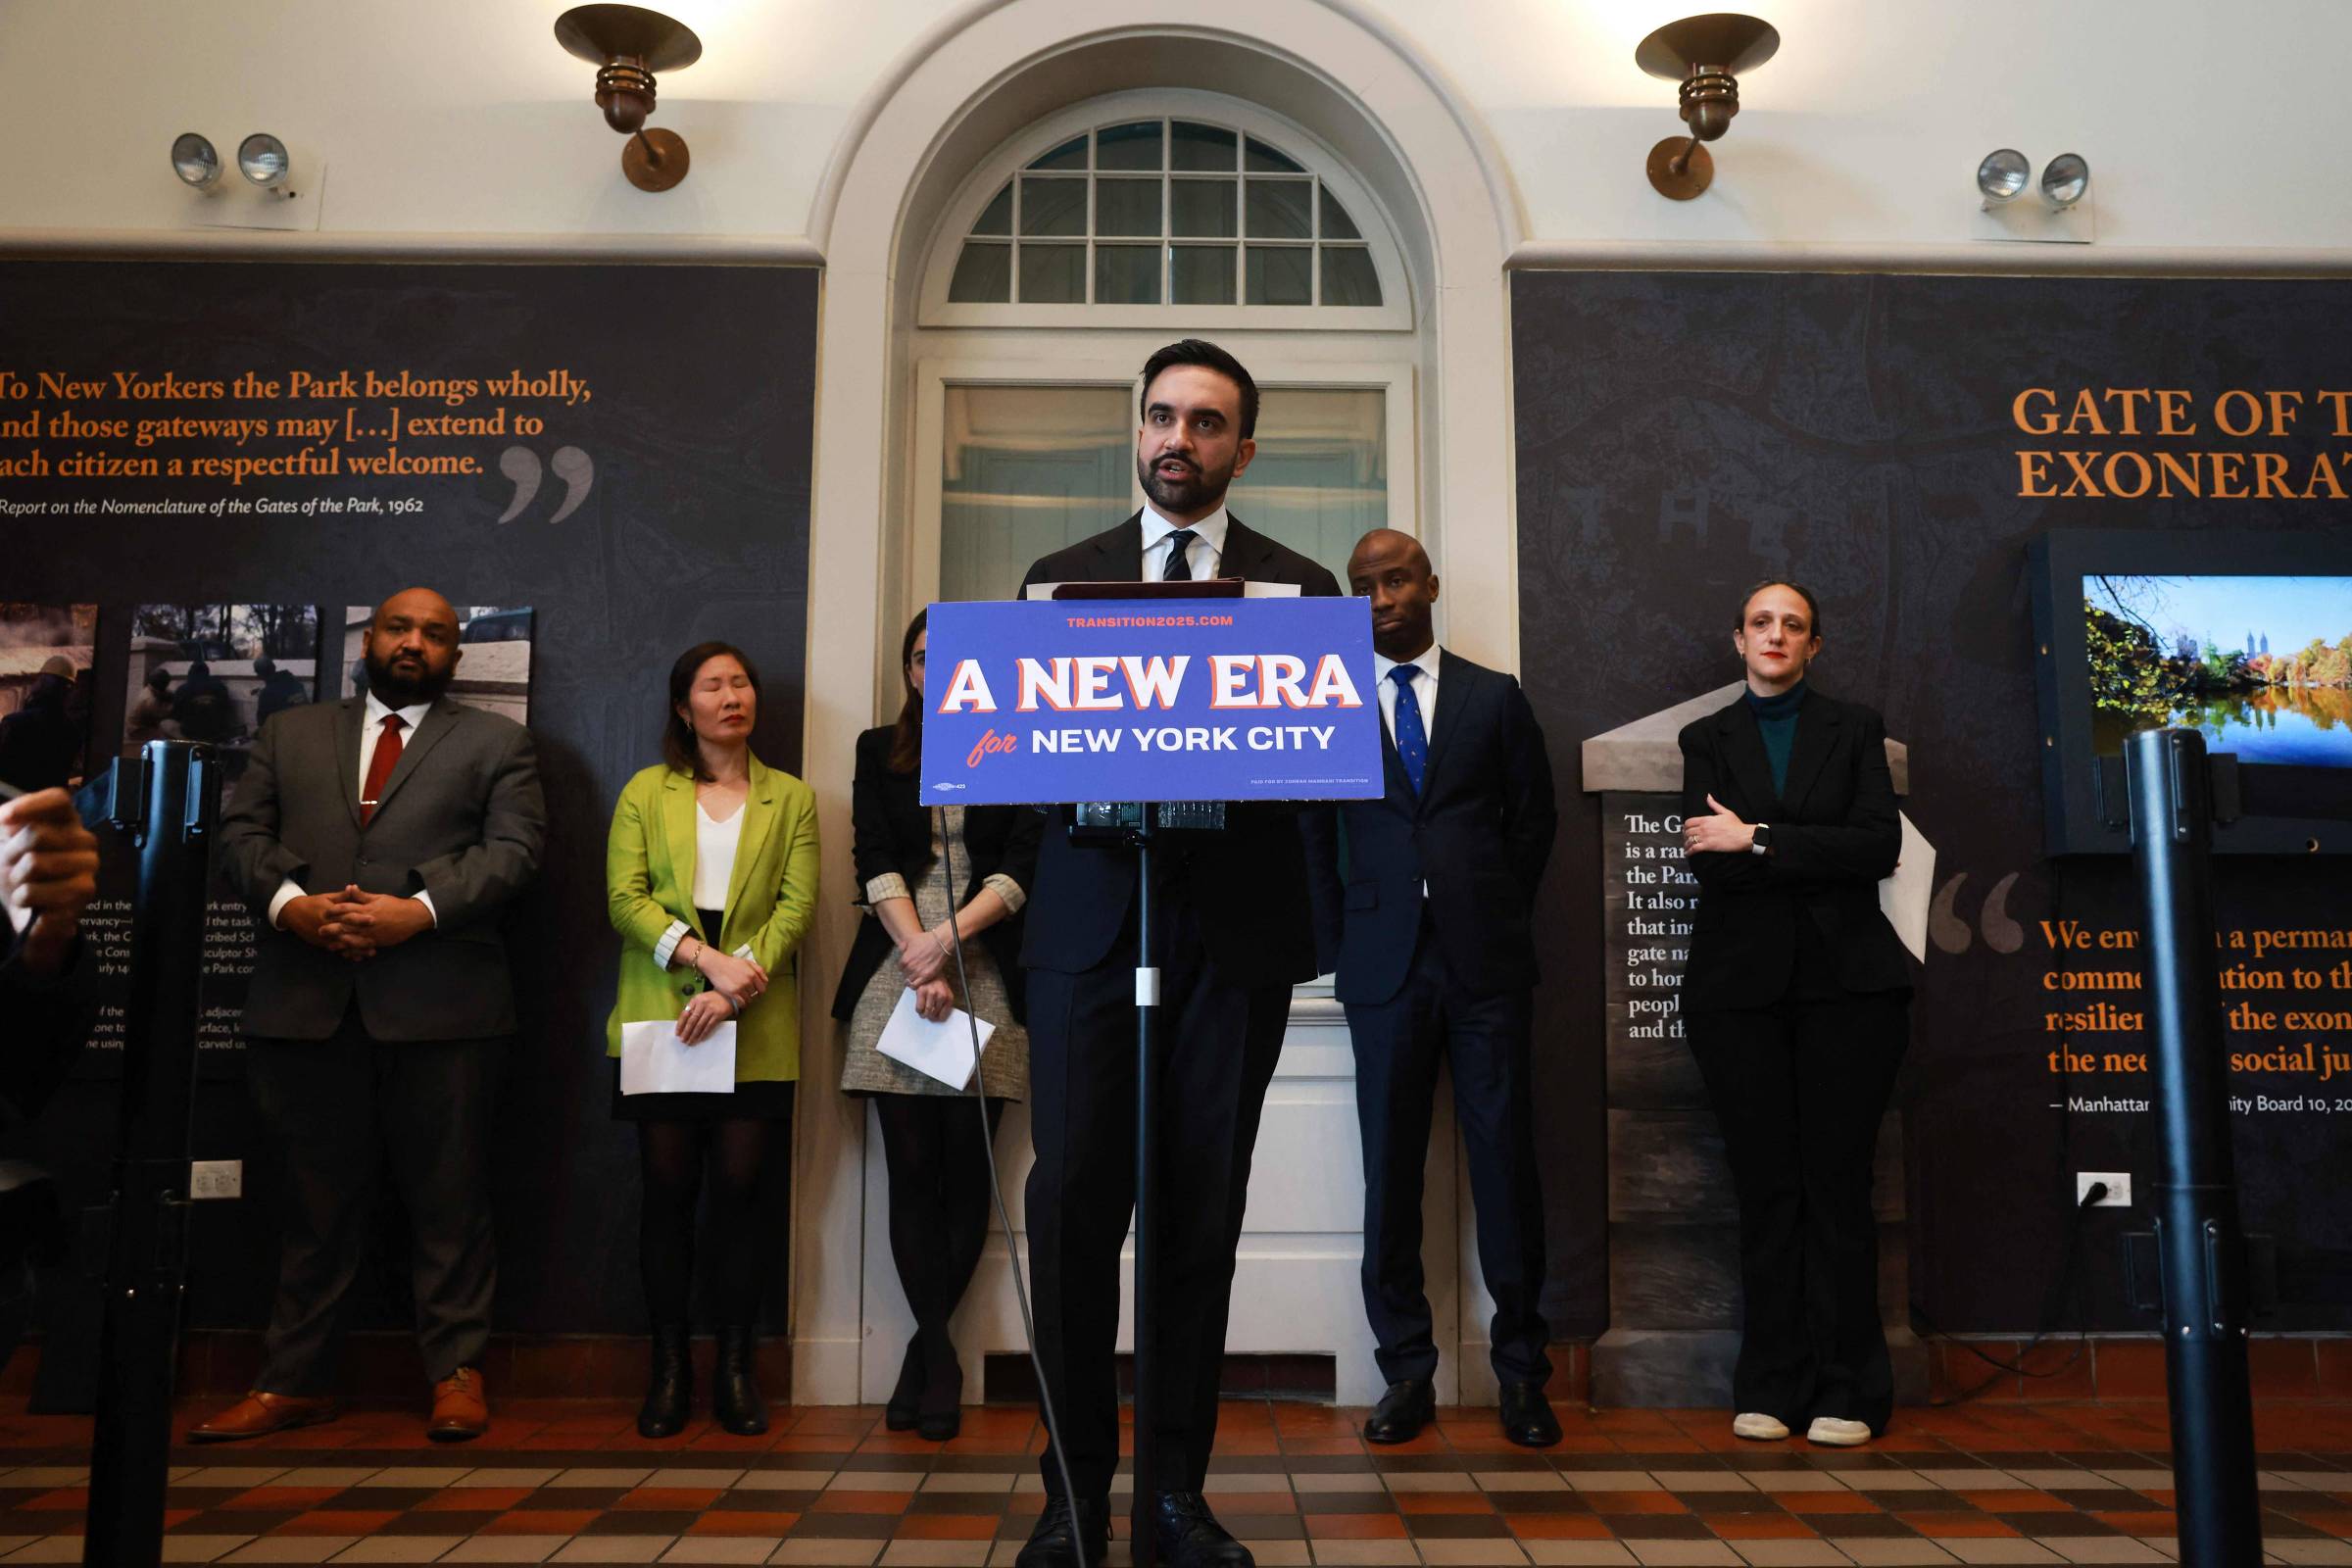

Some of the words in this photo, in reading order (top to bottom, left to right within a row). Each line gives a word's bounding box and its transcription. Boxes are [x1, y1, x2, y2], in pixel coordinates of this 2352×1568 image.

[0, 370, 29, 400] To
[36, 370, 108, 400] New
[113, 369, 224, 400] Yorkers
[233, 369, 280, 399] the
[289, 369, 359, 399] Park
[365, 368, 479, 406] belongs
[485, 368, 592, 405] wholly,
[2012, 387, 2198, 436] GATE
[2214, 389, 2304, 437] OF
[49, 409, 129, 438] those
[135, 416, 269, 447] gateways
[275, 416, 339, 444] may
[407, 407, 506, 436] extend
[513, 413, 544, 436] to
[58, 450, 159, 477] citizen
[167, 458, 184, 476] a
[191, 447, 340, 484] respectful
[347, 445, 483, 475] welcome.
[2015, 450, 2352, 499] EXONERA
[0, 498, 47, 517] Report
[50, 501, 70, 514] on
[74, 498, 97, 514] the
[101, 498, 206, 514] Nomenclature
[209, 498, 226, 517] of
[227, 498, 252, 514] the
[255, 498, 298, 514] Gates
[300, 497, 318, 517] of
[319, 497, 344, 514] the
[347, 498, 384, 515] Park,
[388, 501, 424, 514] 1962
[1066, 614, 1233, 629] TRANSITION2025.COM
[937, 658, 998, 714] A
[1014, 655, 1192, 712] NEW
[1207, 653, 1364, 710] ERA
[966, 728, 1017, 768] for
[1032, 728, 1123, 755] NEW
[1131, 726, 1239, 753] YORK
[1247, 725, 1336, 752] CITY
[1624, 814, 1660, 833] The
[1625, 842, 1641, 858] is
[1644, 846, 1656, 858] a
[1626, 865, 1656, 884] the
[1661, 865, 1699, 884] Par
[115, 900, 132, 909] the
[1627, 891, 1643, 909] It
[1647, 891, 1685, 909] also
[1627, 916, 1666, 935] that
[2038, 919, 2093, 950] We
[103, 931, 120, 941] the
[2229, 929, 2247, 950] a
[1628, 948, 1667, 966] gate
[212, 962, 235, 973] Park
[1628, 970, 1646, 987] to
[2292, 966, 2323, 990] to
[2228, 1001, 2278, 1031] the
[1629, 1019, 1664, 1039] and
[2047, 1042, 2096, 1073] the
[2230, 1042, 2317, 1073] social
[2257, 1094, 2304, 1112] Board
[2308, 1098, 2330, 1114] 10,
